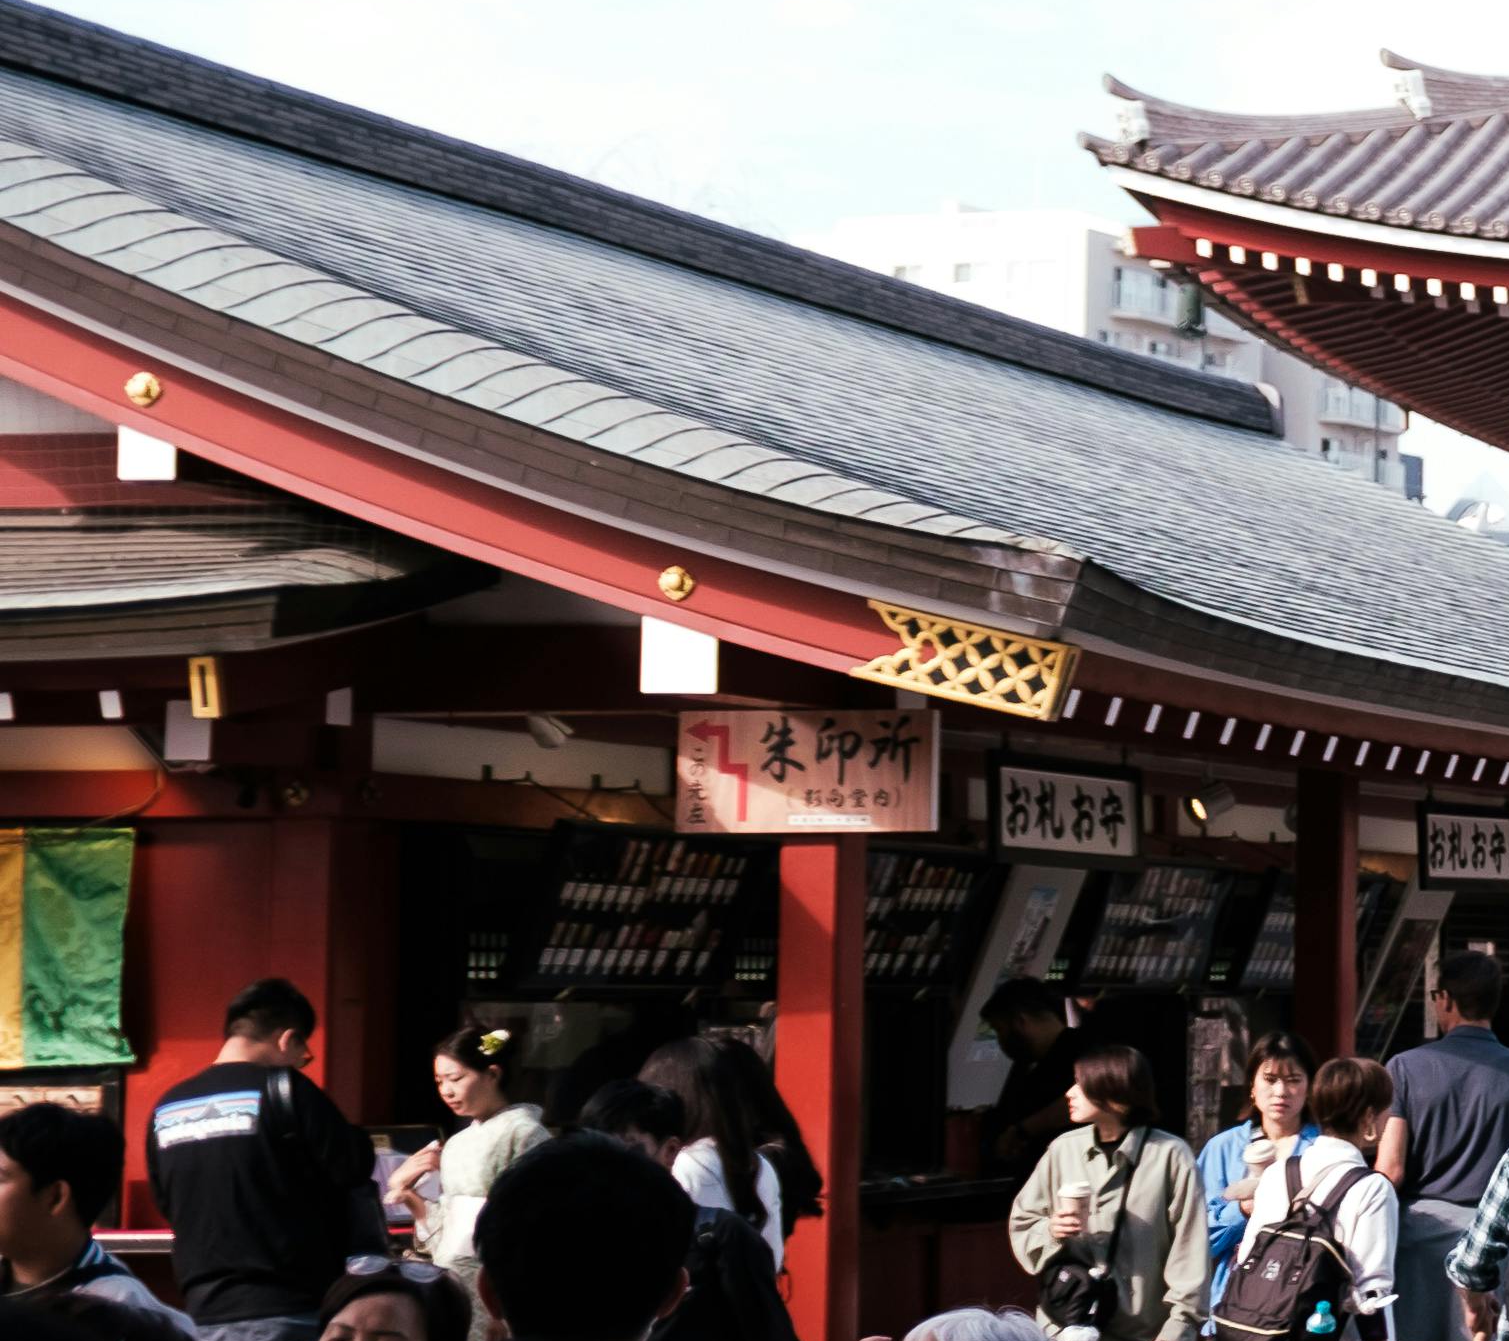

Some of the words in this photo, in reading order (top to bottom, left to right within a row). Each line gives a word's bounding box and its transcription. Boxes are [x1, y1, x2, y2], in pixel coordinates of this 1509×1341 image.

[759, 715, 922, 786] 朱印所
[1006, 777, 1125, 849] お札お守
[1430, 821, 1507, 875] お札お守
